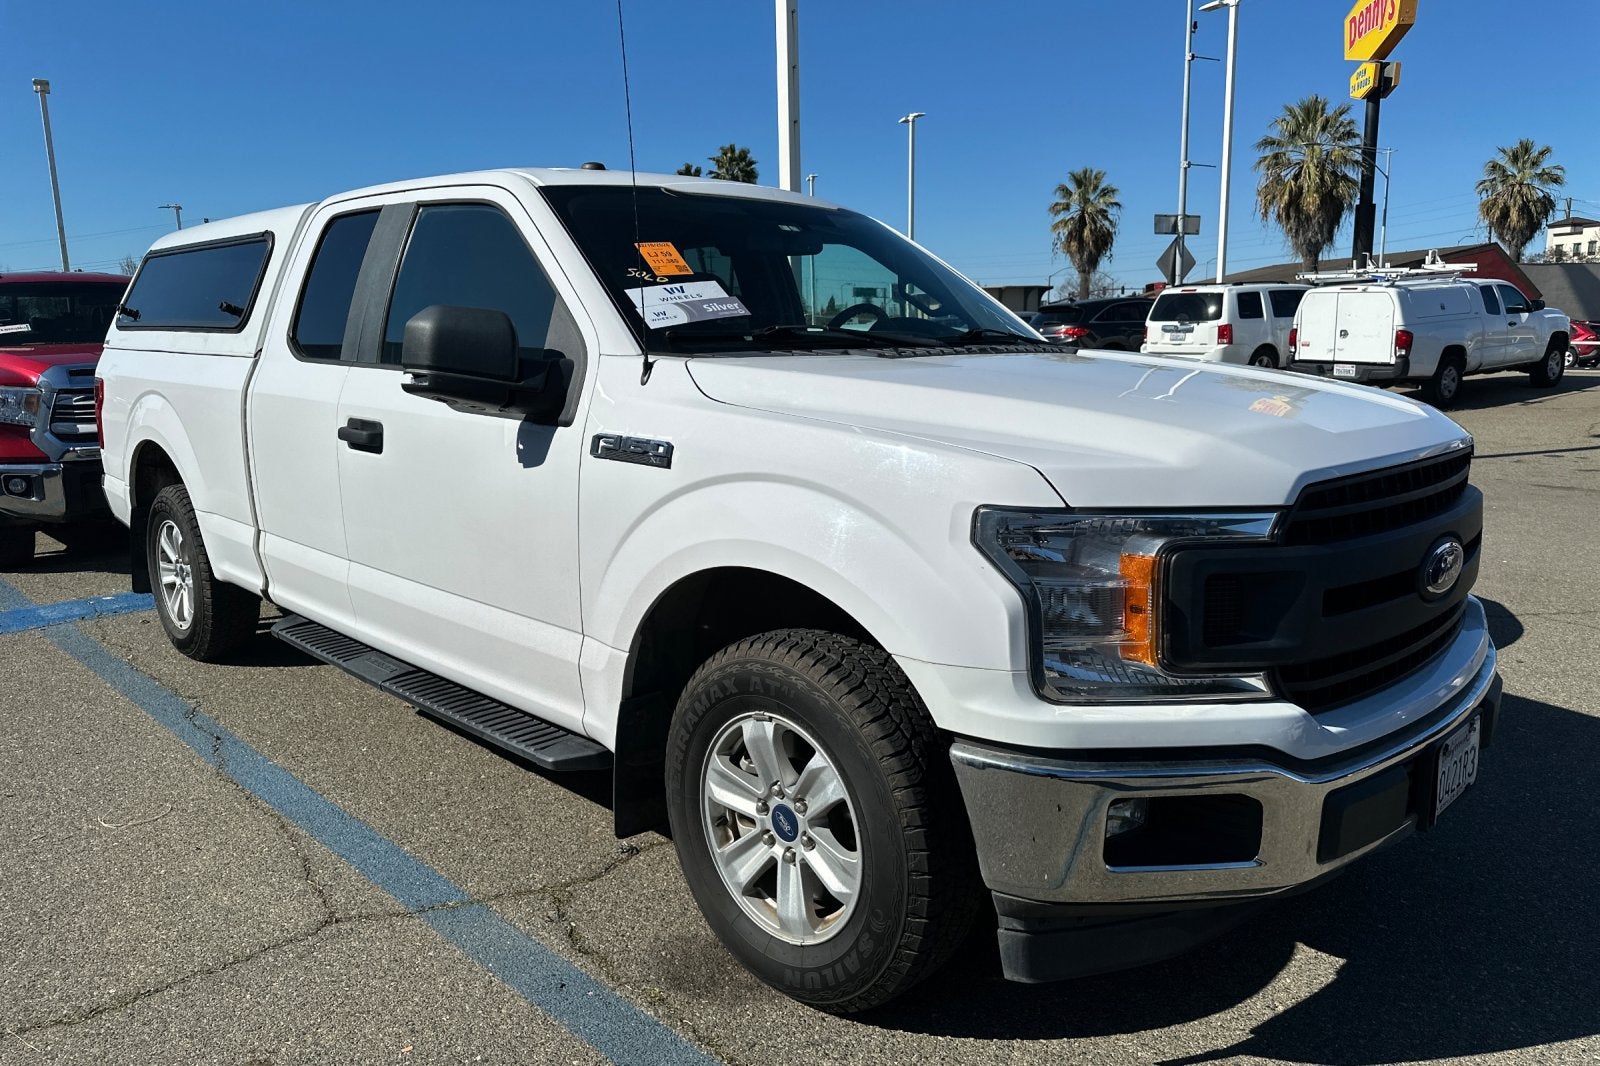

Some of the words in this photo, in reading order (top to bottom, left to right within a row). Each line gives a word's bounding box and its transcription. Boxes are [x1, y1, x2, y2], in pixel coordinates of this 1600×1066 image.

[1348, 0, 1396, 52] Dennys
[1356, 68, 1367, 80] OPEN
[1356, 76, 1371, 91] HOURS
[658, 293, 703, 302] WHEELS
[702, 302, 740, 312] Silver
[783, 931, 875, 989] SAILUN
